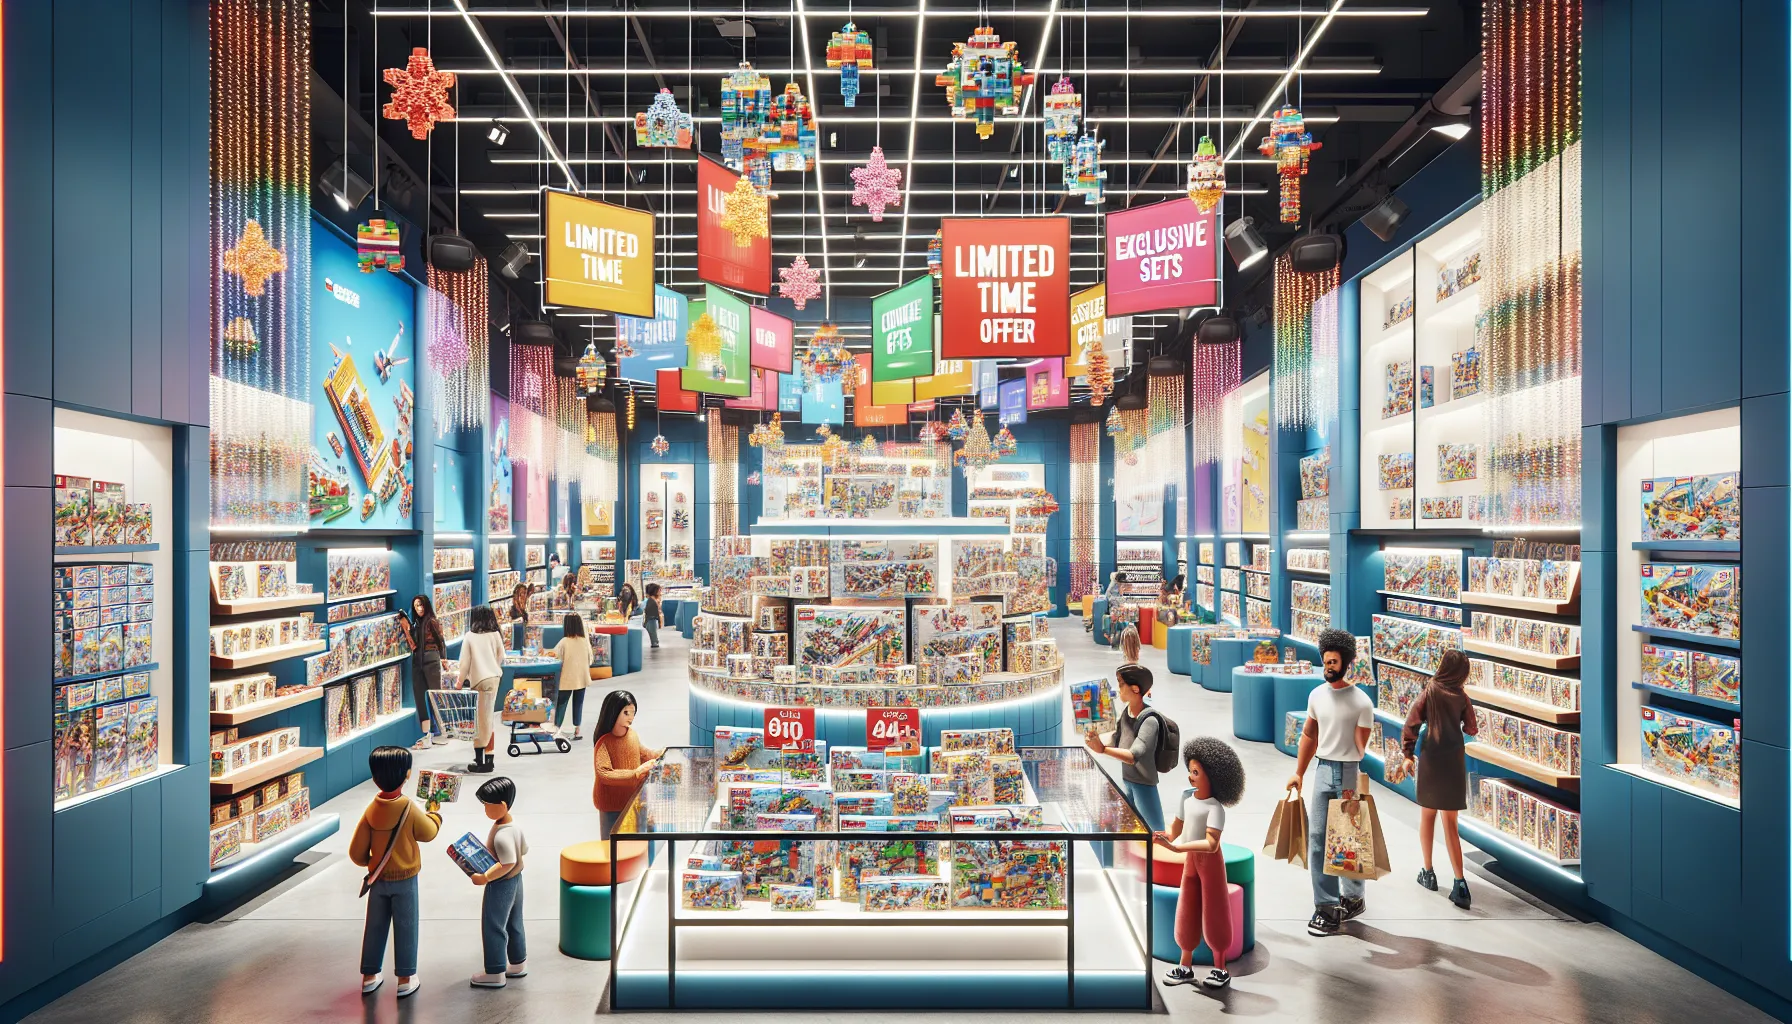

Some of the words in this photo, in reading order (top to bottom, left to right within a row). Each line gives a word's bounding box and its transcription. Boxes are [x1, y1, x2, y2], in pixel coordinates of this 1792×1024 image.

[565, 221, 638, 258] LIMITED
[1115, 220, 1208, 260] EXCLUSIVE
[581, 253, 623, 285] TIME
[955, 245, 1055, 278] LIMITED
[1140, 253, 1183, 282] SETS
[978, 281, 1037, 314] TIME
[980, 318, 1036, 344] OFFER
